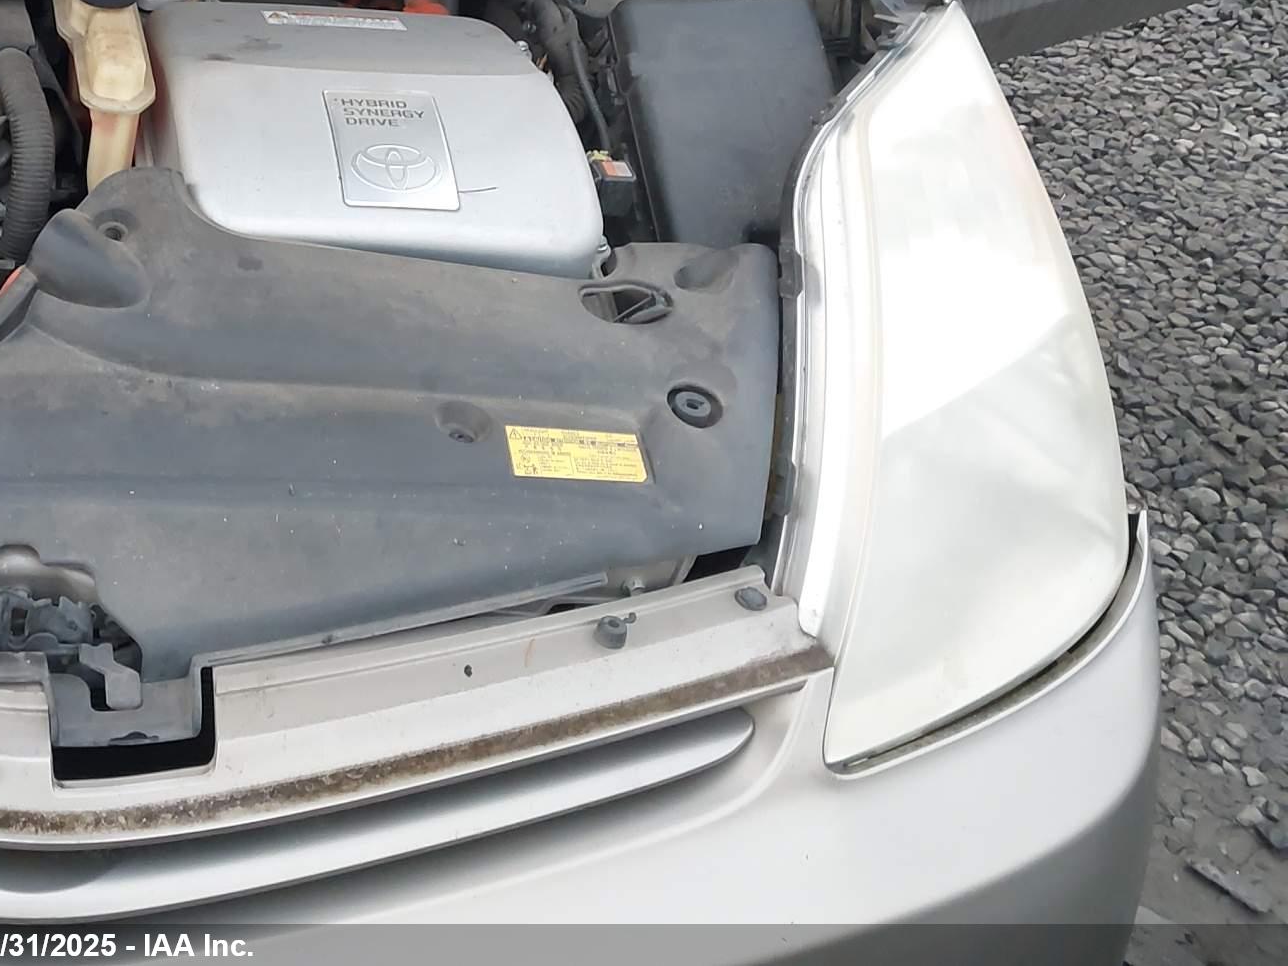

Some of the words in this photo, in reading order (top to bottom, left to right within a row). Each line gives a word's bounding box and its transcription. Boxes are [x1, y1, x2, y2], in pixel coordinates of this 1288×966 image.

[341, 98, 407, 109] HYBRID
[343, 108, 425, 119] SYNERGY
[345, 117, 400, 127] DRIVE
